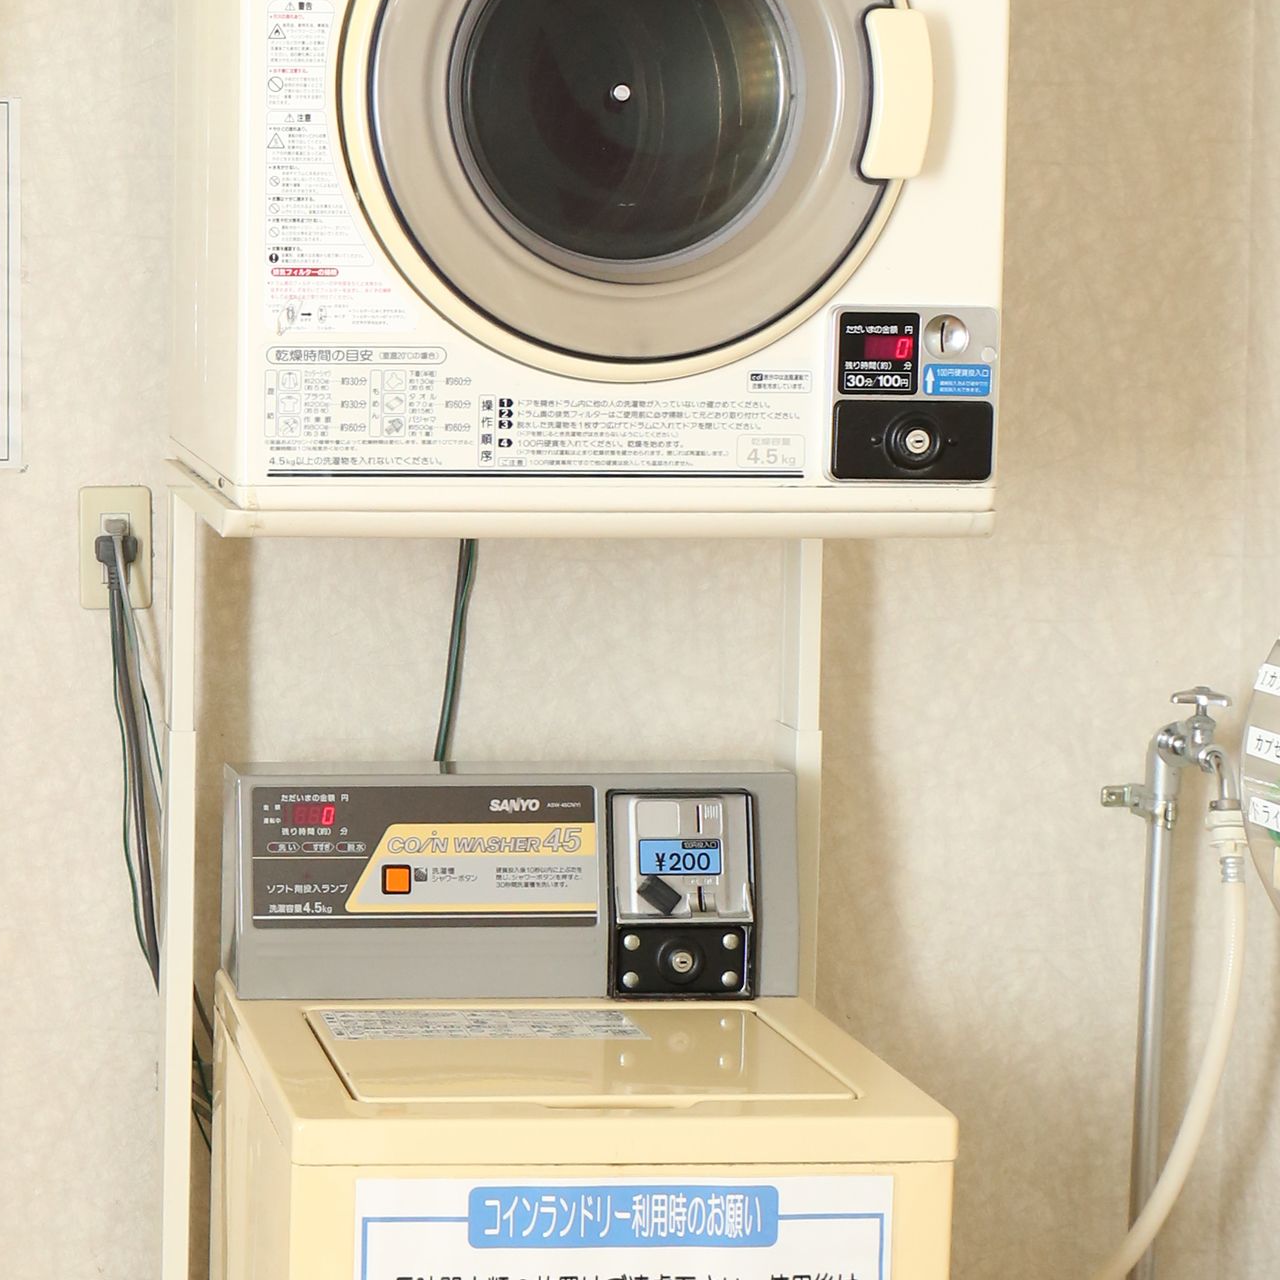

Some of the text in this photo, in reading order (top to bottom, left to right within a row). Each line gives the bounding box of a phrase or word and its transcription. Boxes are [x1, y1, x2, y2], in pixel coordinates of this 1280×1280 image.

[904, 325, 914, 334] 円
[275, 349, 374, 362] 乾燥時間の目安
[895, 338, 911, 359] 0
[903, 361, 913, 371] 分
[846, 375, 909, 387] 30分/100円
[480, 400, 493, 462] 操作順序
[746, 448, 796, 467] 4.5 kg
[340, 793, 349, 802] 円
[489, 797, 541, 815] SANYO
[321, 806, 335, 825] 0
[339, 827, 348, 836] 分
[454, 835, 541, 854] WASHER
[542, 827, 583, 854] 45
[655, 852, 711, 872] ¥200
[482, 1192, 762, 1241] コインランドリー利用時のお願い
